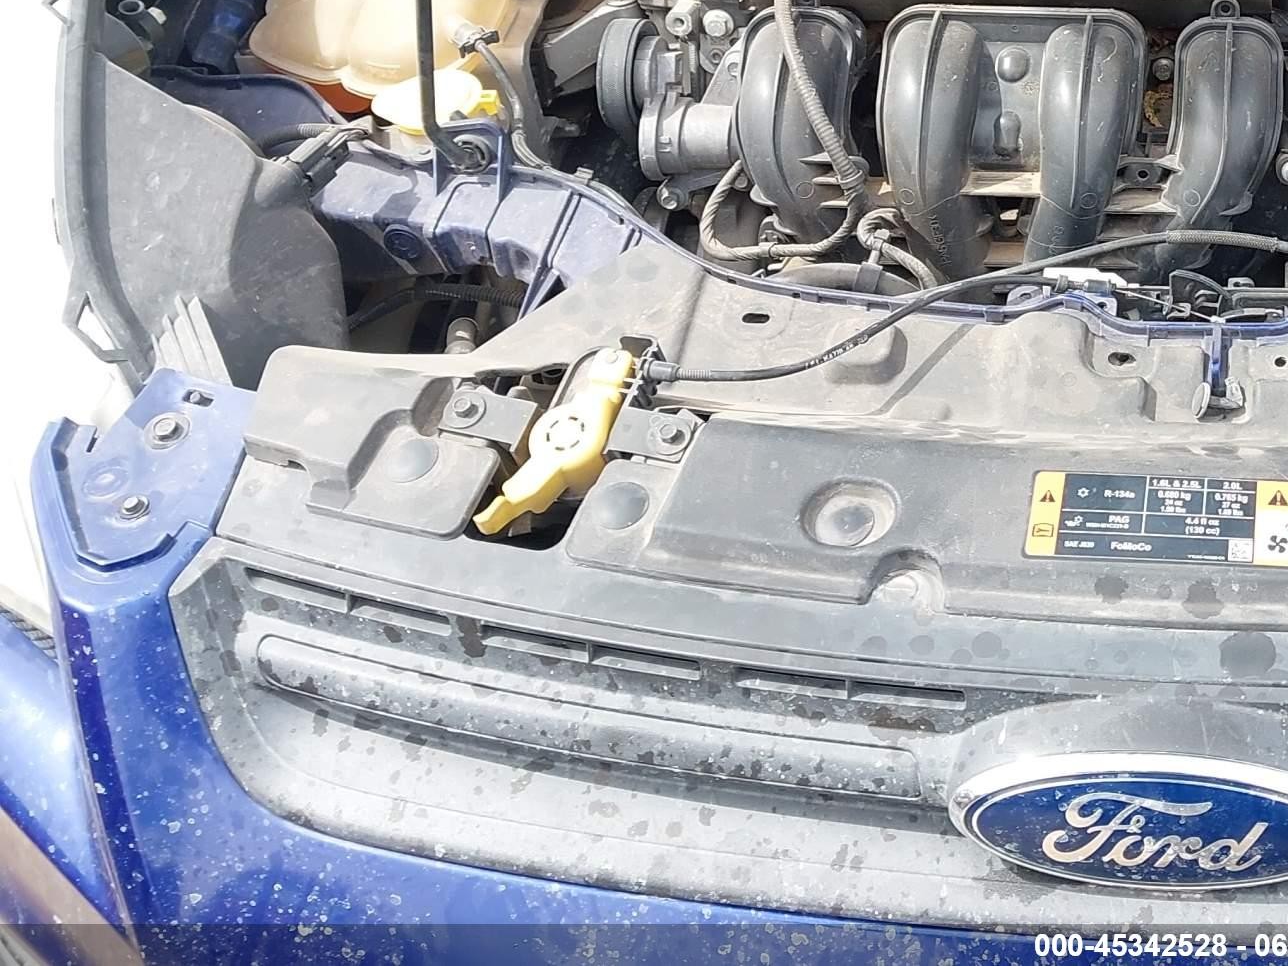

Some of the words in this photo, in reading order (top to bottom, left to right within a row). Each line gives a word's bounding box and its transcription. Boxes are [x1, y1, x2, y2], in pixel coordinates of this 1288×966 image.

[1222, 481, 1243, 491] 2.0L
[1103, 489, 1136, 499] R-134a
[1180, 491, 1192, 502] kg
[1237, 494, 1249, 504] kg
[1108, 515, 1130, 523] PAG
[1185, 526, 1205, 535] (130
[1205, 527, 1220, 536] cc)
[1110, 541, 1153, 552] FoMoCo
[1042, 792, 1268, 871] Ford
